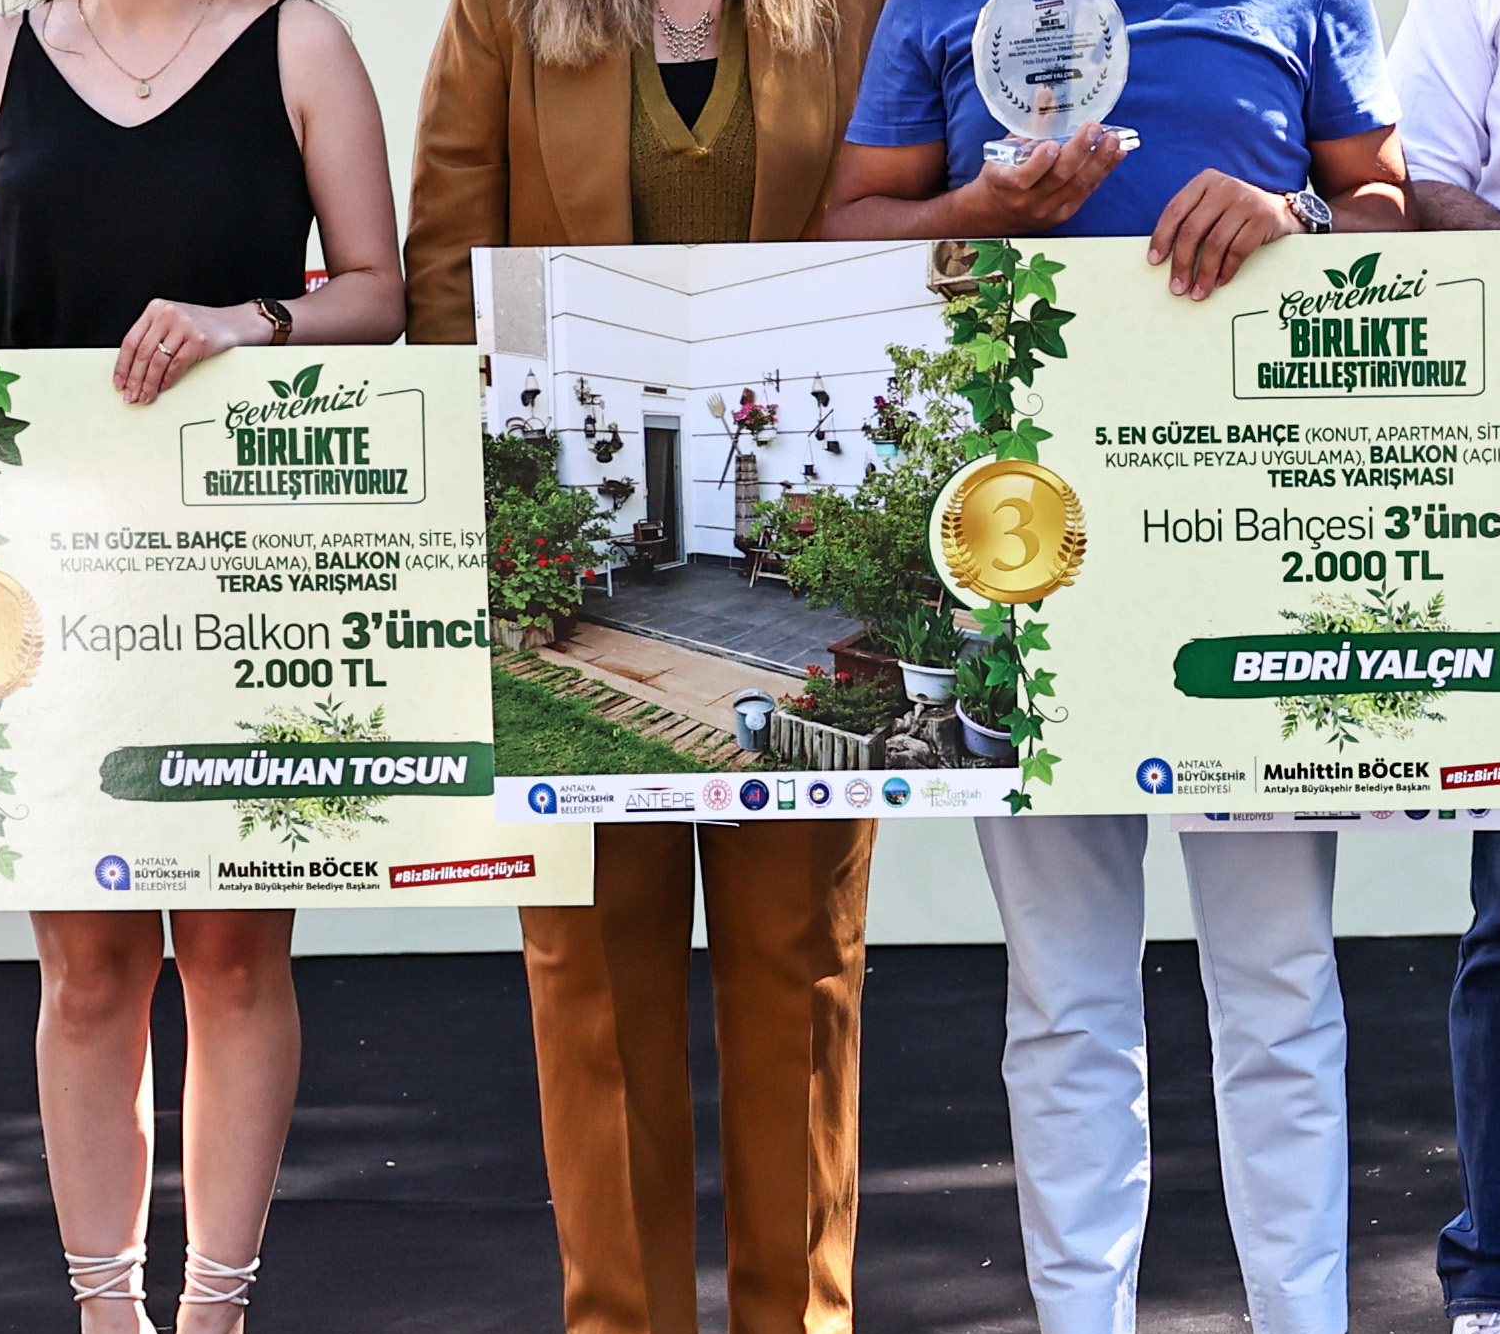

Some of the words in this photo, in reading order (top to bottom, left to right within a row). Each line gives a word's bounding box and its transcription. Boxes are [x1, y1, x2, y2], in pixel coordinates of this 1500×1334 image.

[1279, 269, 1427, 329] Çevremizi
[225, 379, 368, 436] Çevremizi
[1096, 427, 1112, 445] 5.
[1118, 427, 1145, 444] EN
[1152, 421, 1222, 444] GÜZEL
[1227, 424, 1299, 446] BAHÇE
[1305, 427, 1371, 444] (KONUT,
[1376, 426, 1472, 442] APARTMAN,
[1106, 452, 1189, 469] KURAKÇIL
[1194, 451, 1256, 466] PEYZAJ
[1262, 450, 1365, 466] UYGULAMA),
[1370, 445, 1457, 464] BALKON
[1268, 469, 1336, 487] TERAS
[1341, 467, 1453, 490] YARIŞMASI
[1144, 509, 1222, 542] Hobi
[1236, 507, 1373, 550] Bahçesi
[1282, 551, 1386, 582] 2.000
[1396, 550, 1443, 580] TL
[216, 574, 283, 592] TERAS
[288, 573, 396, 595] YARIŞMASI
[62, 614, 181, 661] Kapalı
[196, 613, 329, 650] Balkon
[234, 659, 332, 688] 2.000
[341, 659, 387, 687] TL
[1232, 641, 1351, 682] BEDRİ
[1359, 646, 1494, 687] YALÇIN
[159, 752, 348, 788] ÜMMÜHAN
[349, 755, 469, 787] TOSUN
[1177, 760, 1222, 768] ANTALYA
[1264, 762, 1353, 780] Muhittin
[1359, 758, 1429, 778] BÖCEK
[1178, 770, 1245, 782] BÜYÜKŞEHİR
[1178, 783, 1230, 794] BELEDİYESİ
[1264, 785, 1299, 795] Antalya
[1302, 784, 1352, 795] Büyükşehir
[1355, 784, 1393, 793] Belediye
[1396, 783, 1430, 793] Başkanı
[625, 793, 695, 809] ANTEPE
[218, 861, 304, 877] Muhittin
[310, 857, 378, 877] BÖCEK
[395, 861, 530, 882] #BizBirlikteGüçlüyüz
